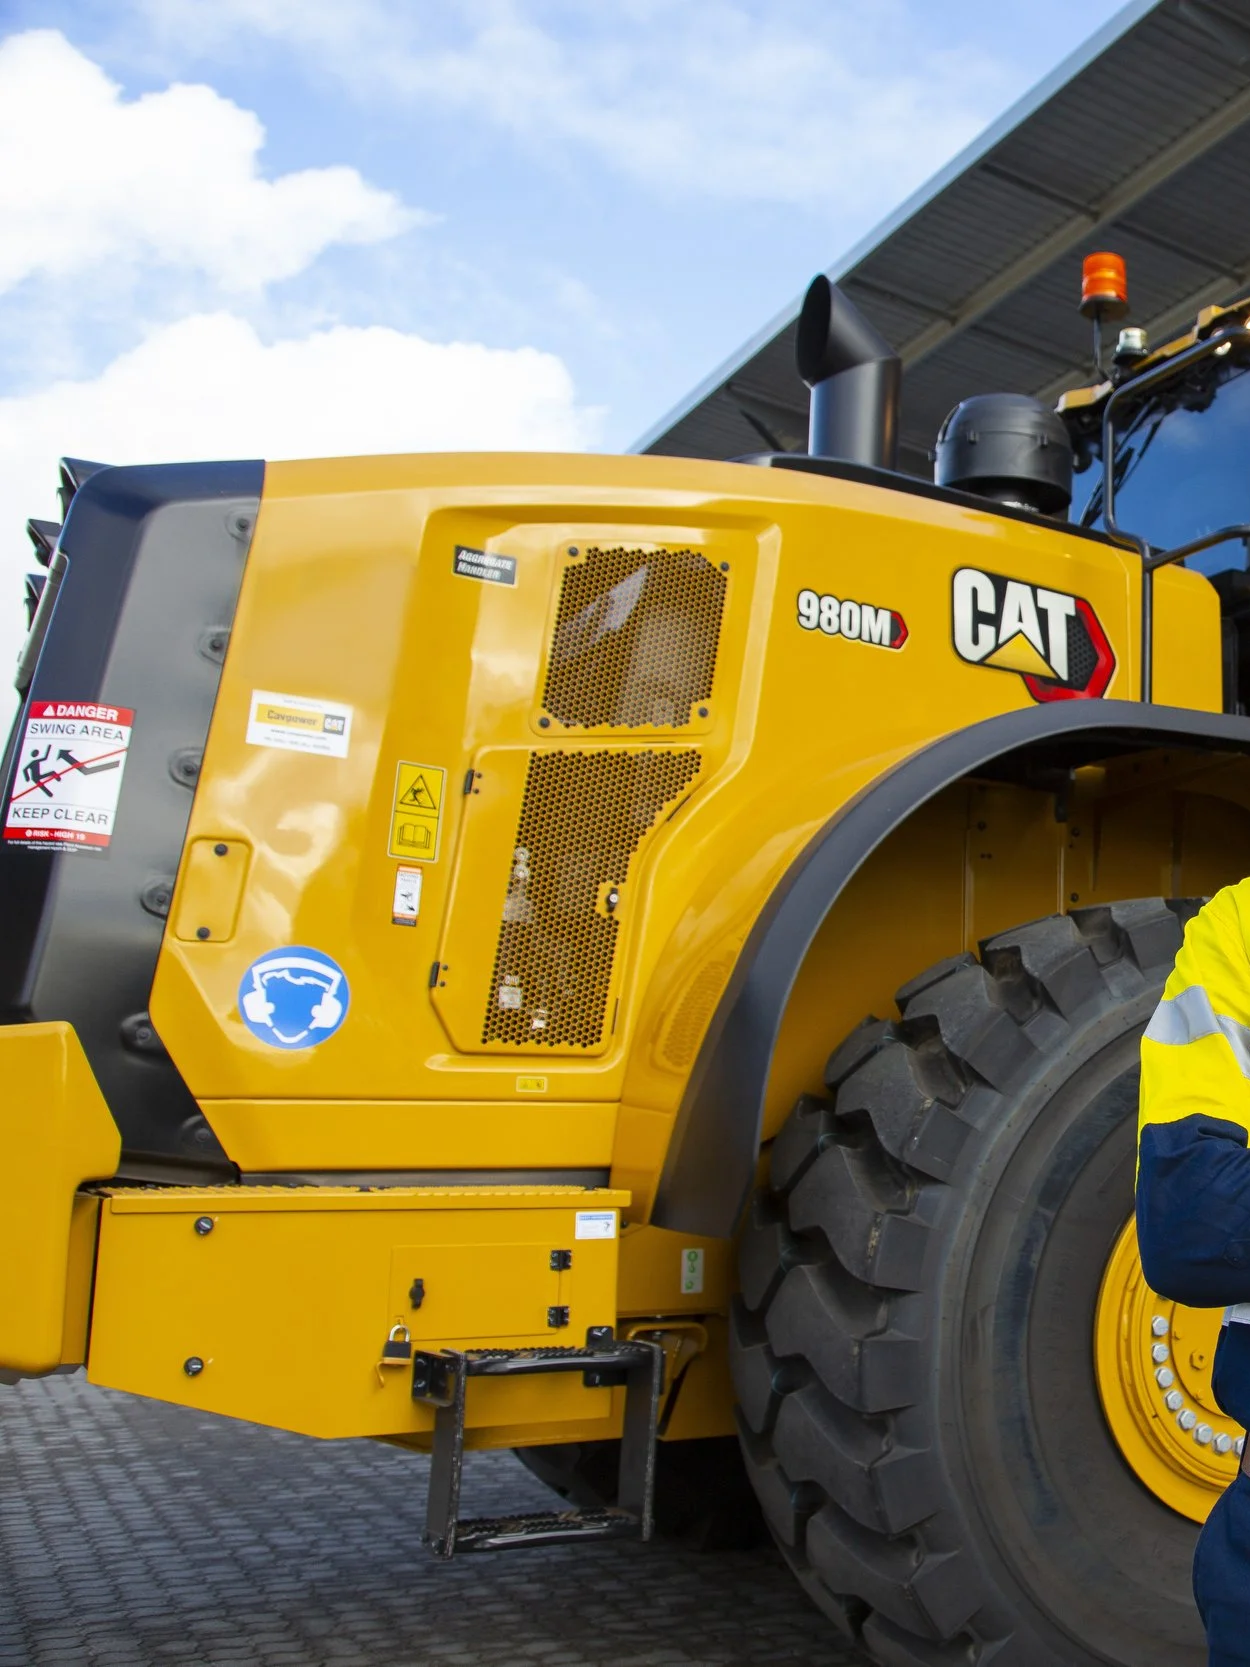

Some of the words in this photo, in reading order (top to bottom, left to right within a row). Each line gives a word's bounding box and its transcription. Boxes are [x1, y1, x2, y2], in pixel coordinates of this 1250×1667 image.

[798, 590, 891, 646] 980M
[953, 567, 1077, 681] CAT
[56, 705, 119, 721] DANGER
[267, 710, 317, 725] Cavpower
[30, 723, 75, 735] SWING
[80, 725, 124, 741] AREA
[12, 807, 50, 819] KEEP
[54, 809, 109, 825] CLEAR
[32, 830, 50, 838] RISK
[54, 831, 74, 840] HIGH
